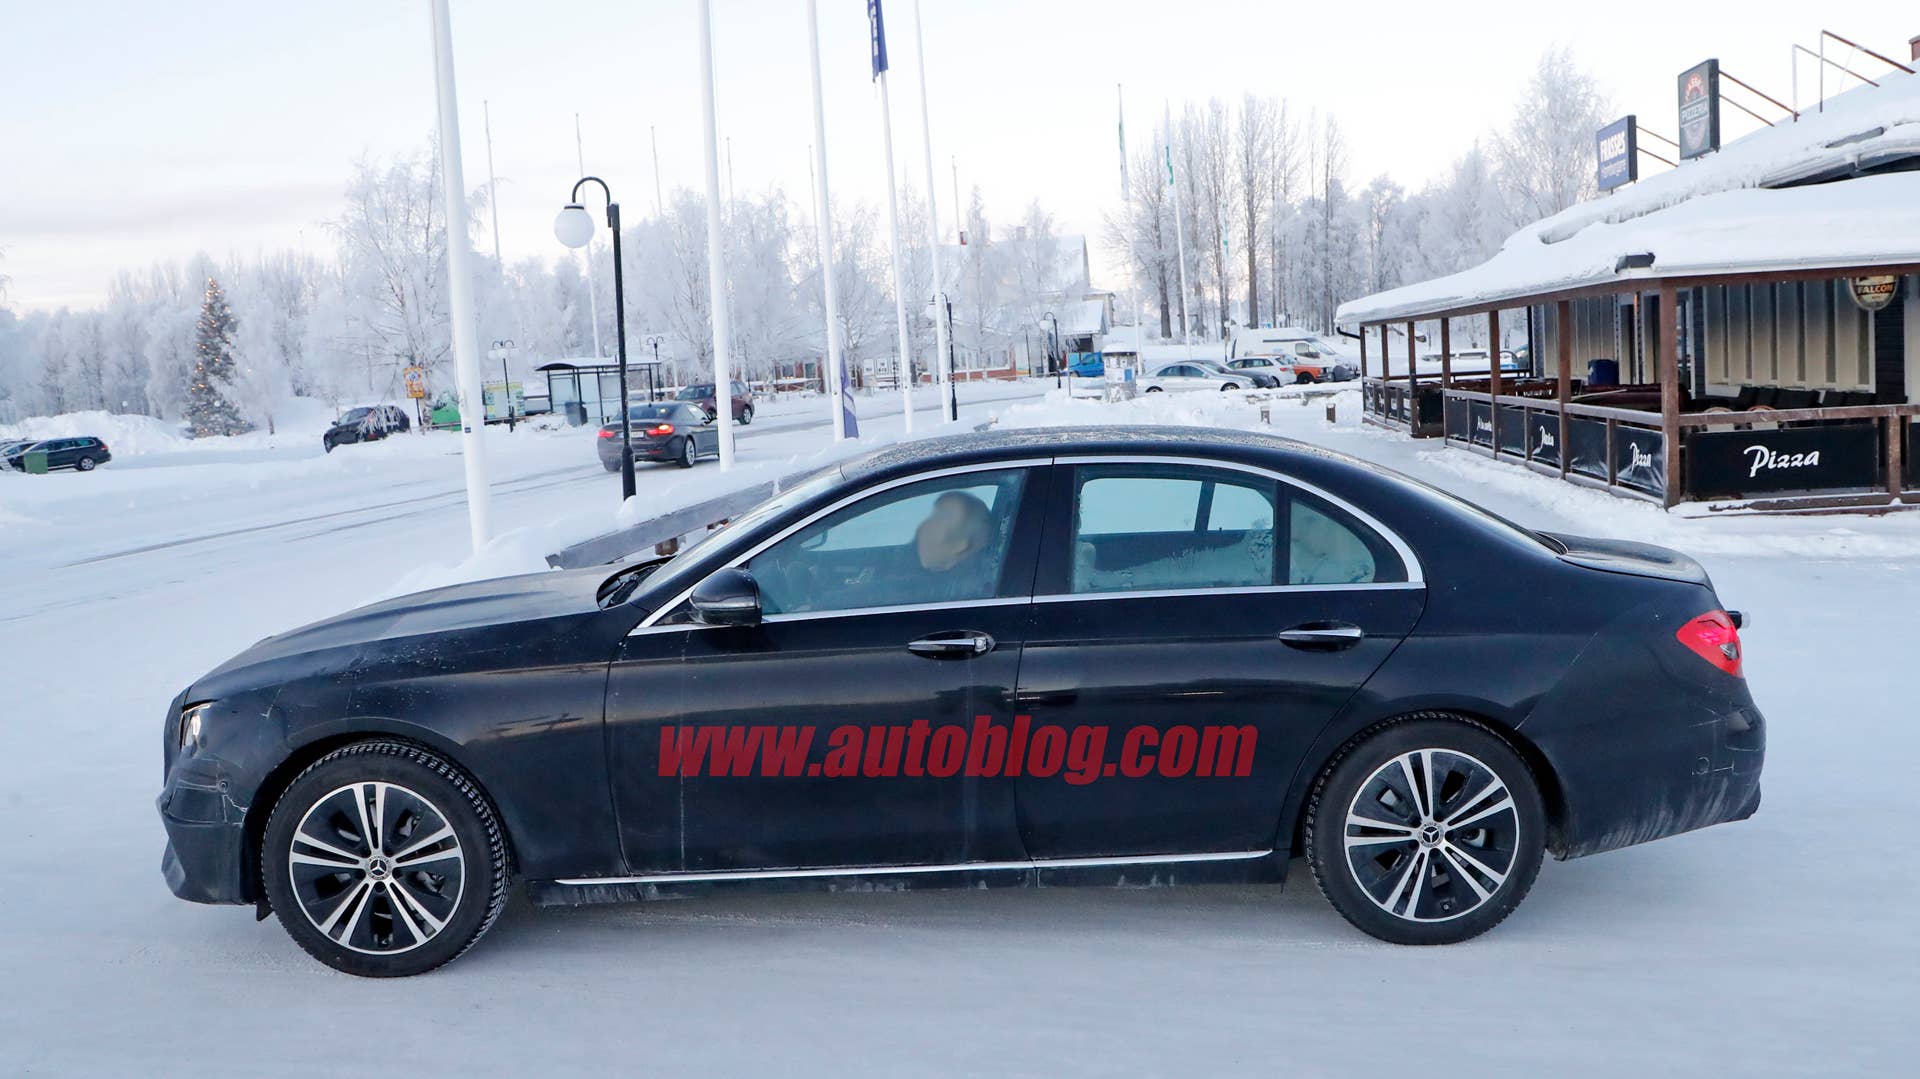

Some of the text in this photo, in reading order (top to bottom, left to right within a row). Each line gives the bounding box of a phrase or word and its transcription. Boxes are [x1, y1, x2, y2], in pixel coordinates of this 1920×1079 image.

[1857, 283, 1894, 294] FALCON
[1629, 441, 1652, 473] Pizza
[1743, 445, 1820, 478] Pizza
